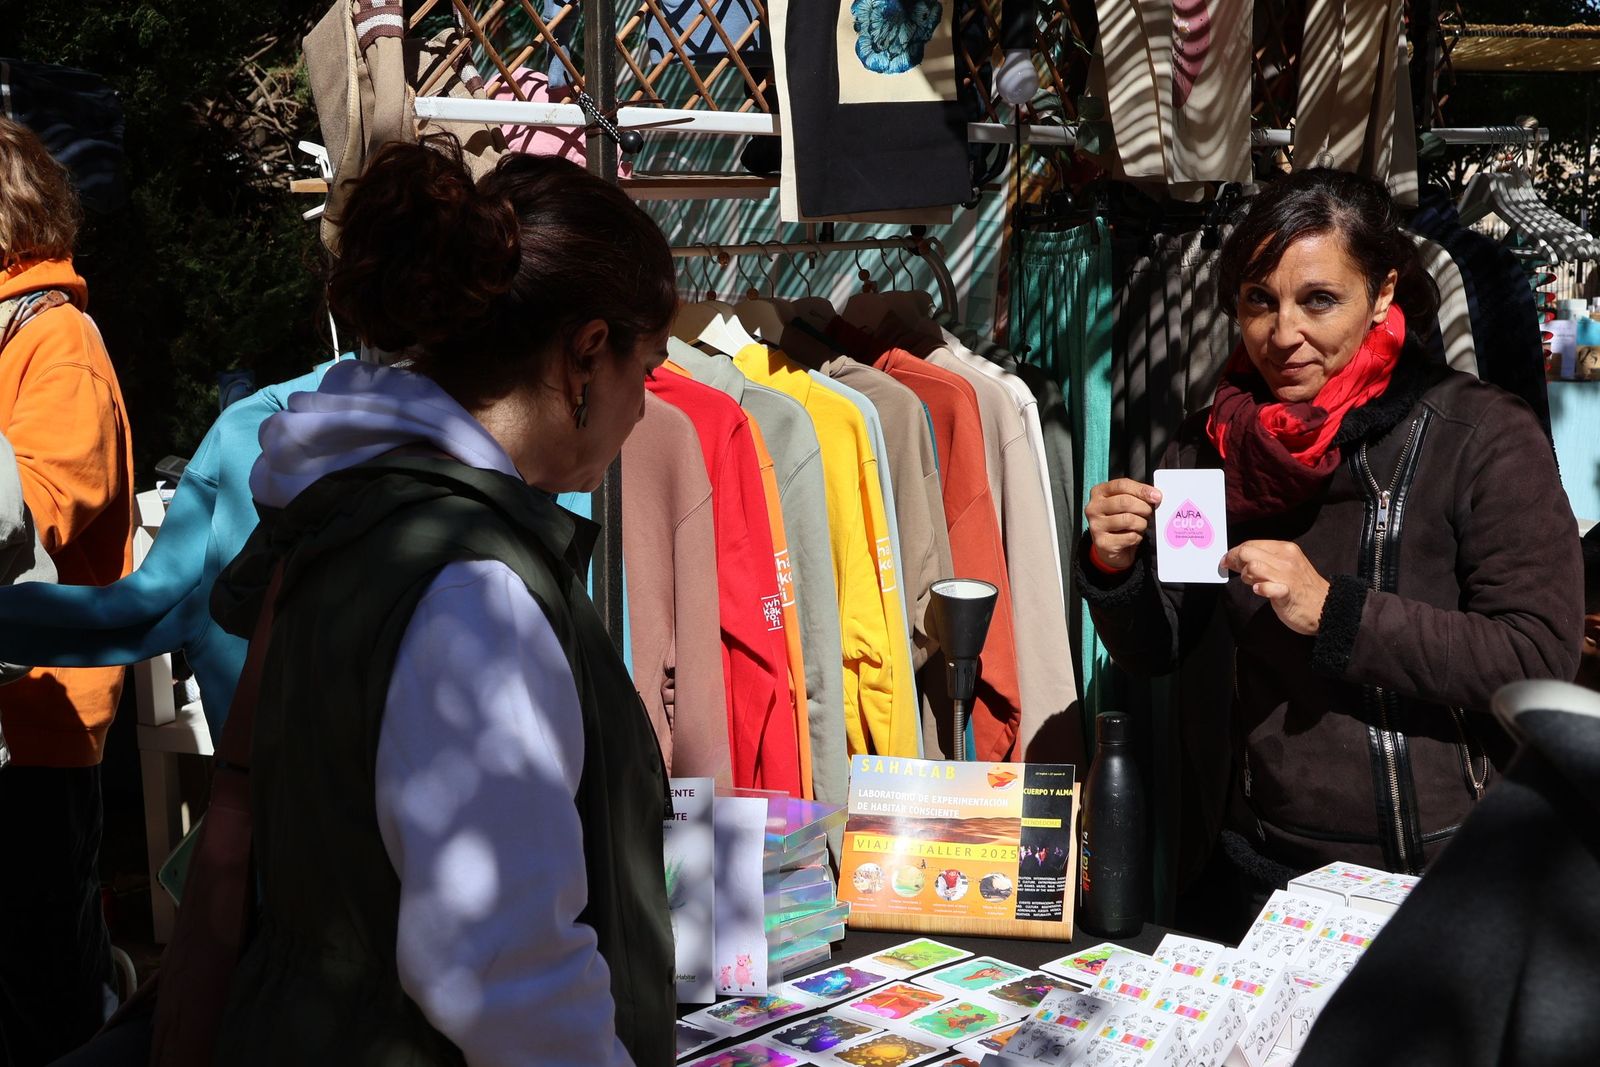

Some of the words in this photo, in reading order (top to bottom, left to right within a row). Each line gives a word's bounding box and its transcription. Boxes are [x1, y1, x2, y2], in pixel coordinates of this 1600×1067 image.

[1175, 510, 1202, 519] AURA
[860, 758, 956, 780] SAHALAB
[858, 788, 917, 802] LABORATORIO
[918, 794, 929, 804] DE
[932, 795, 1009, 808] EXPERIMENTACIÓN
[1023, 787, 1048, 796] CUERPO
[857, 802, 868, 810] DE
[909, 807, 960, 817] CONSCIENTE
[980, 848, 1017, 860] 2025
